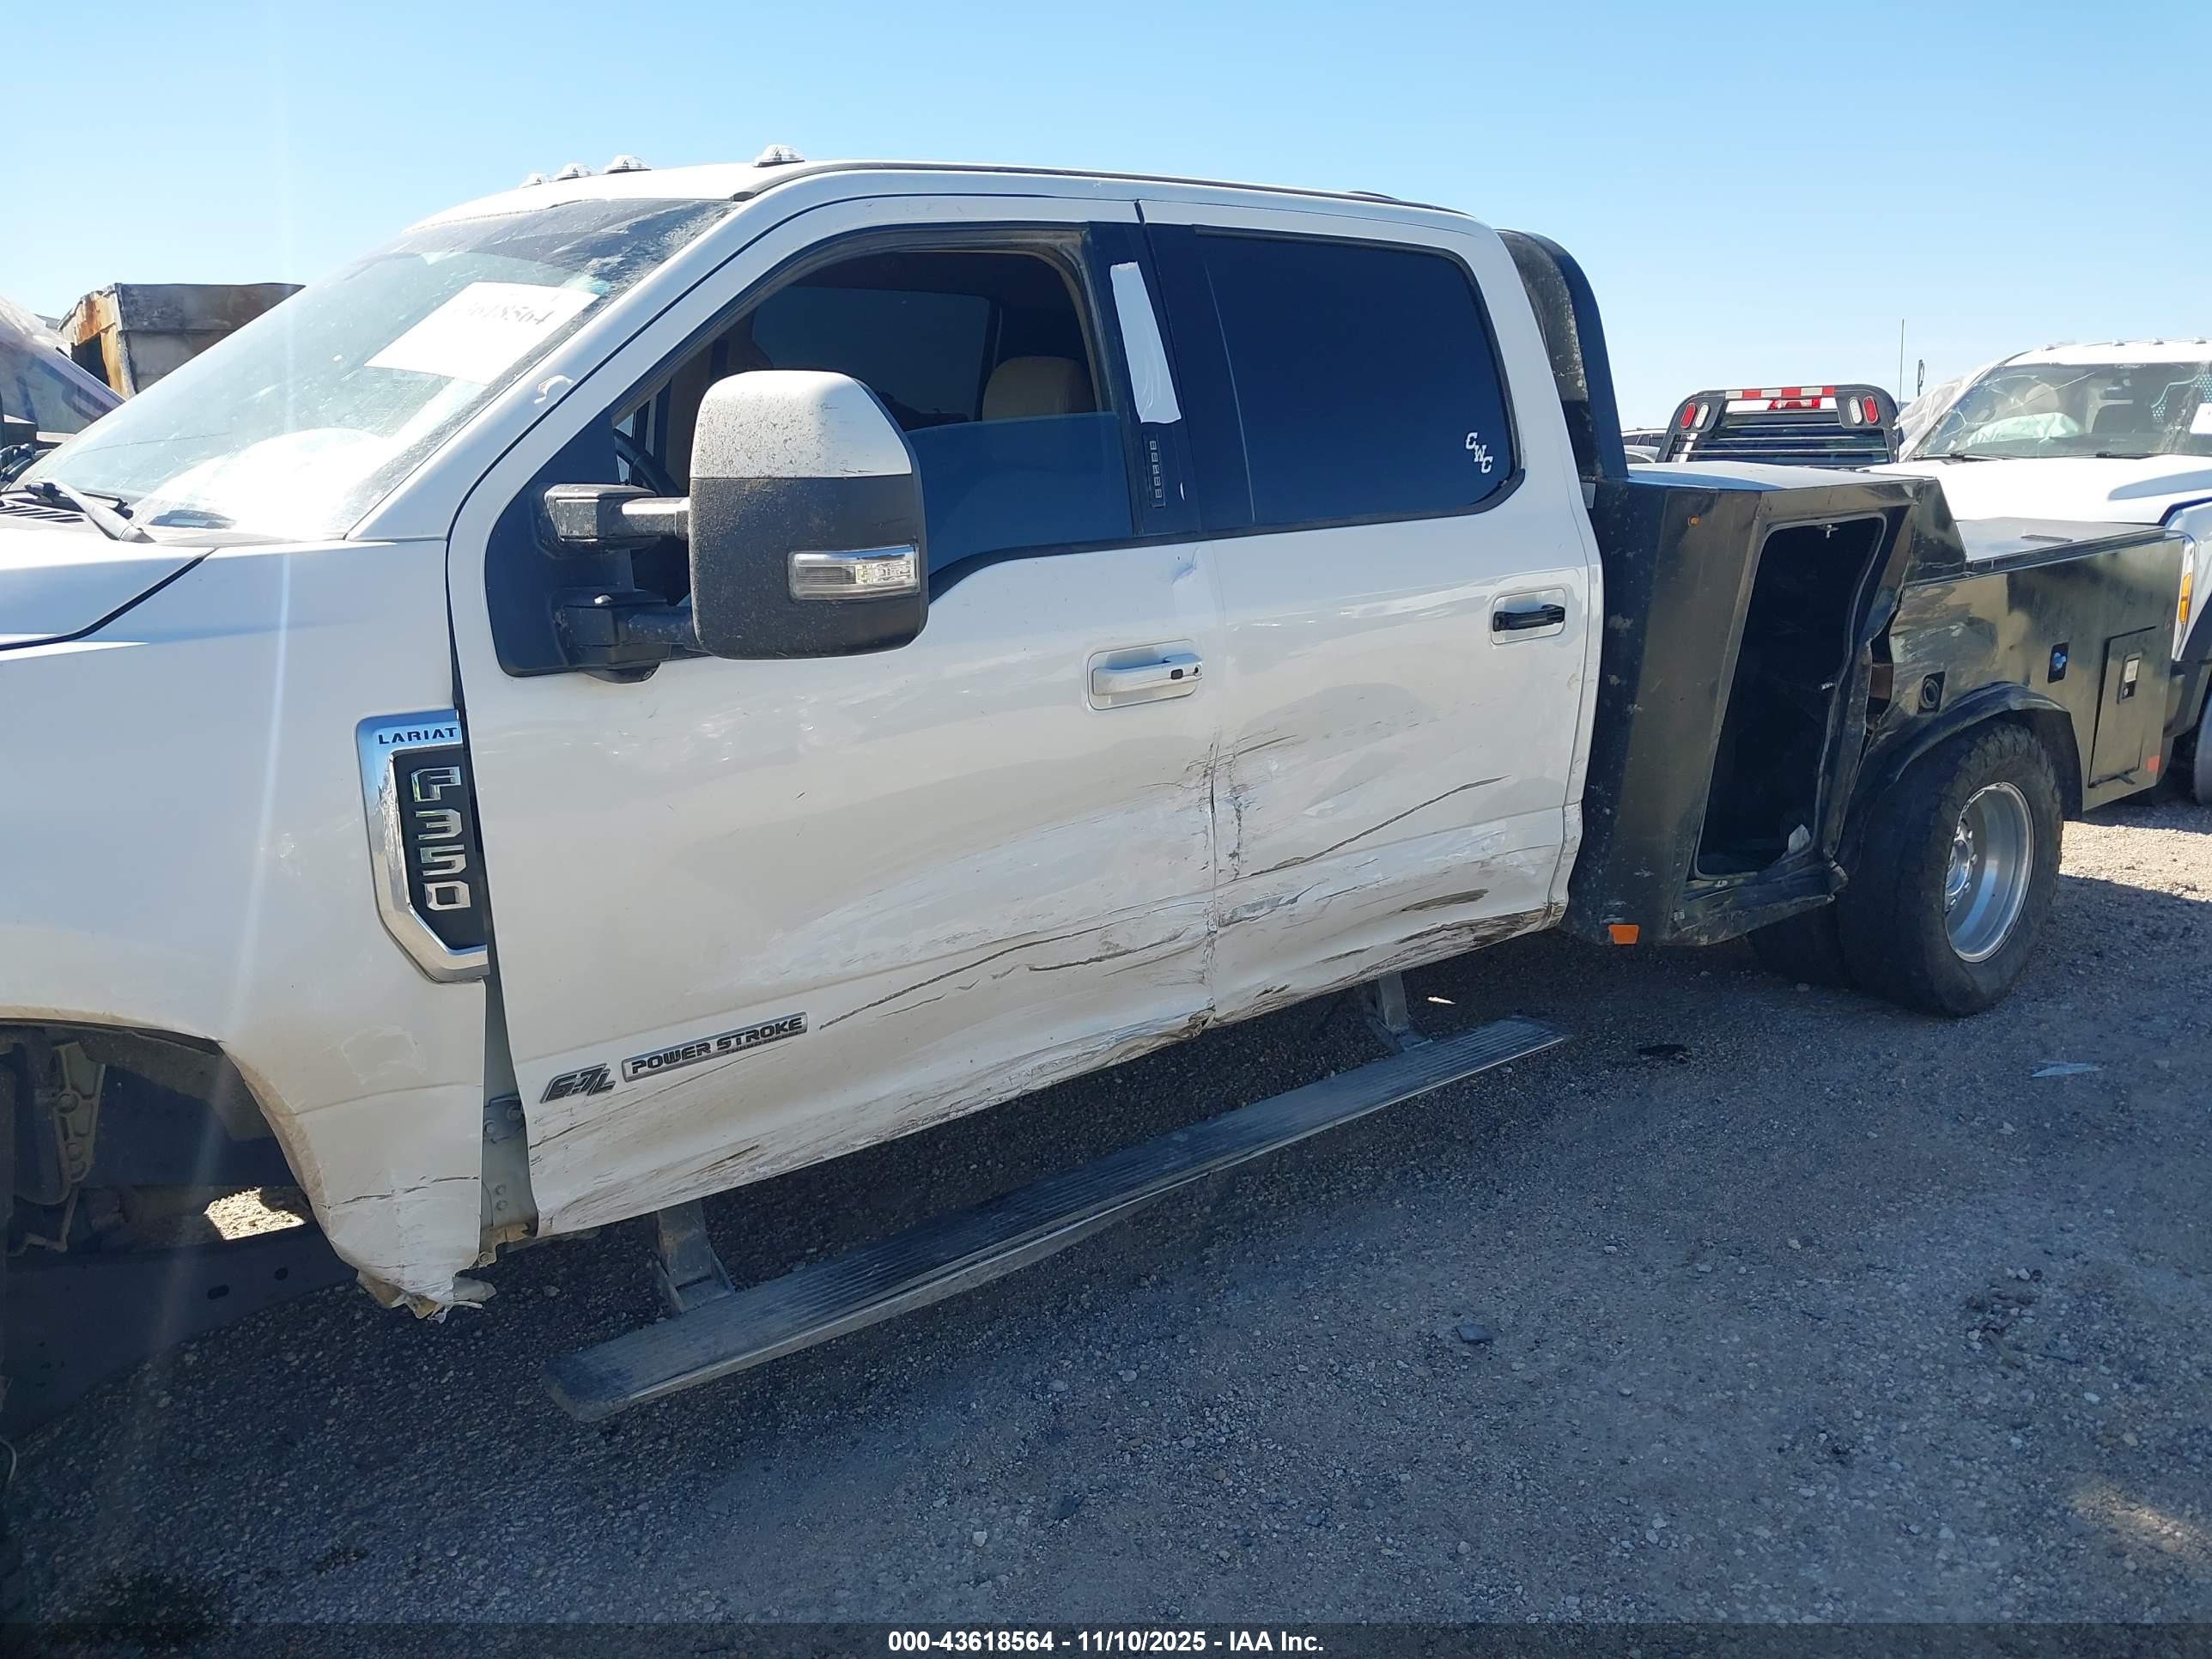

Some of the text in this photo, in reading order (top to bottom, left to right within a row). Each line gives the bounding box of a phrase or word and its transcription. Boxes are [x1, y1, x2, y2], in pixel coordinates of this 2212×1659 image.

[378, 726, 457, 744] LARIAT
[410, 766, 471, 911] F350
[631, 1043, 711, 1074] POWER
[716, 1017, 802, 1049] STROKE
